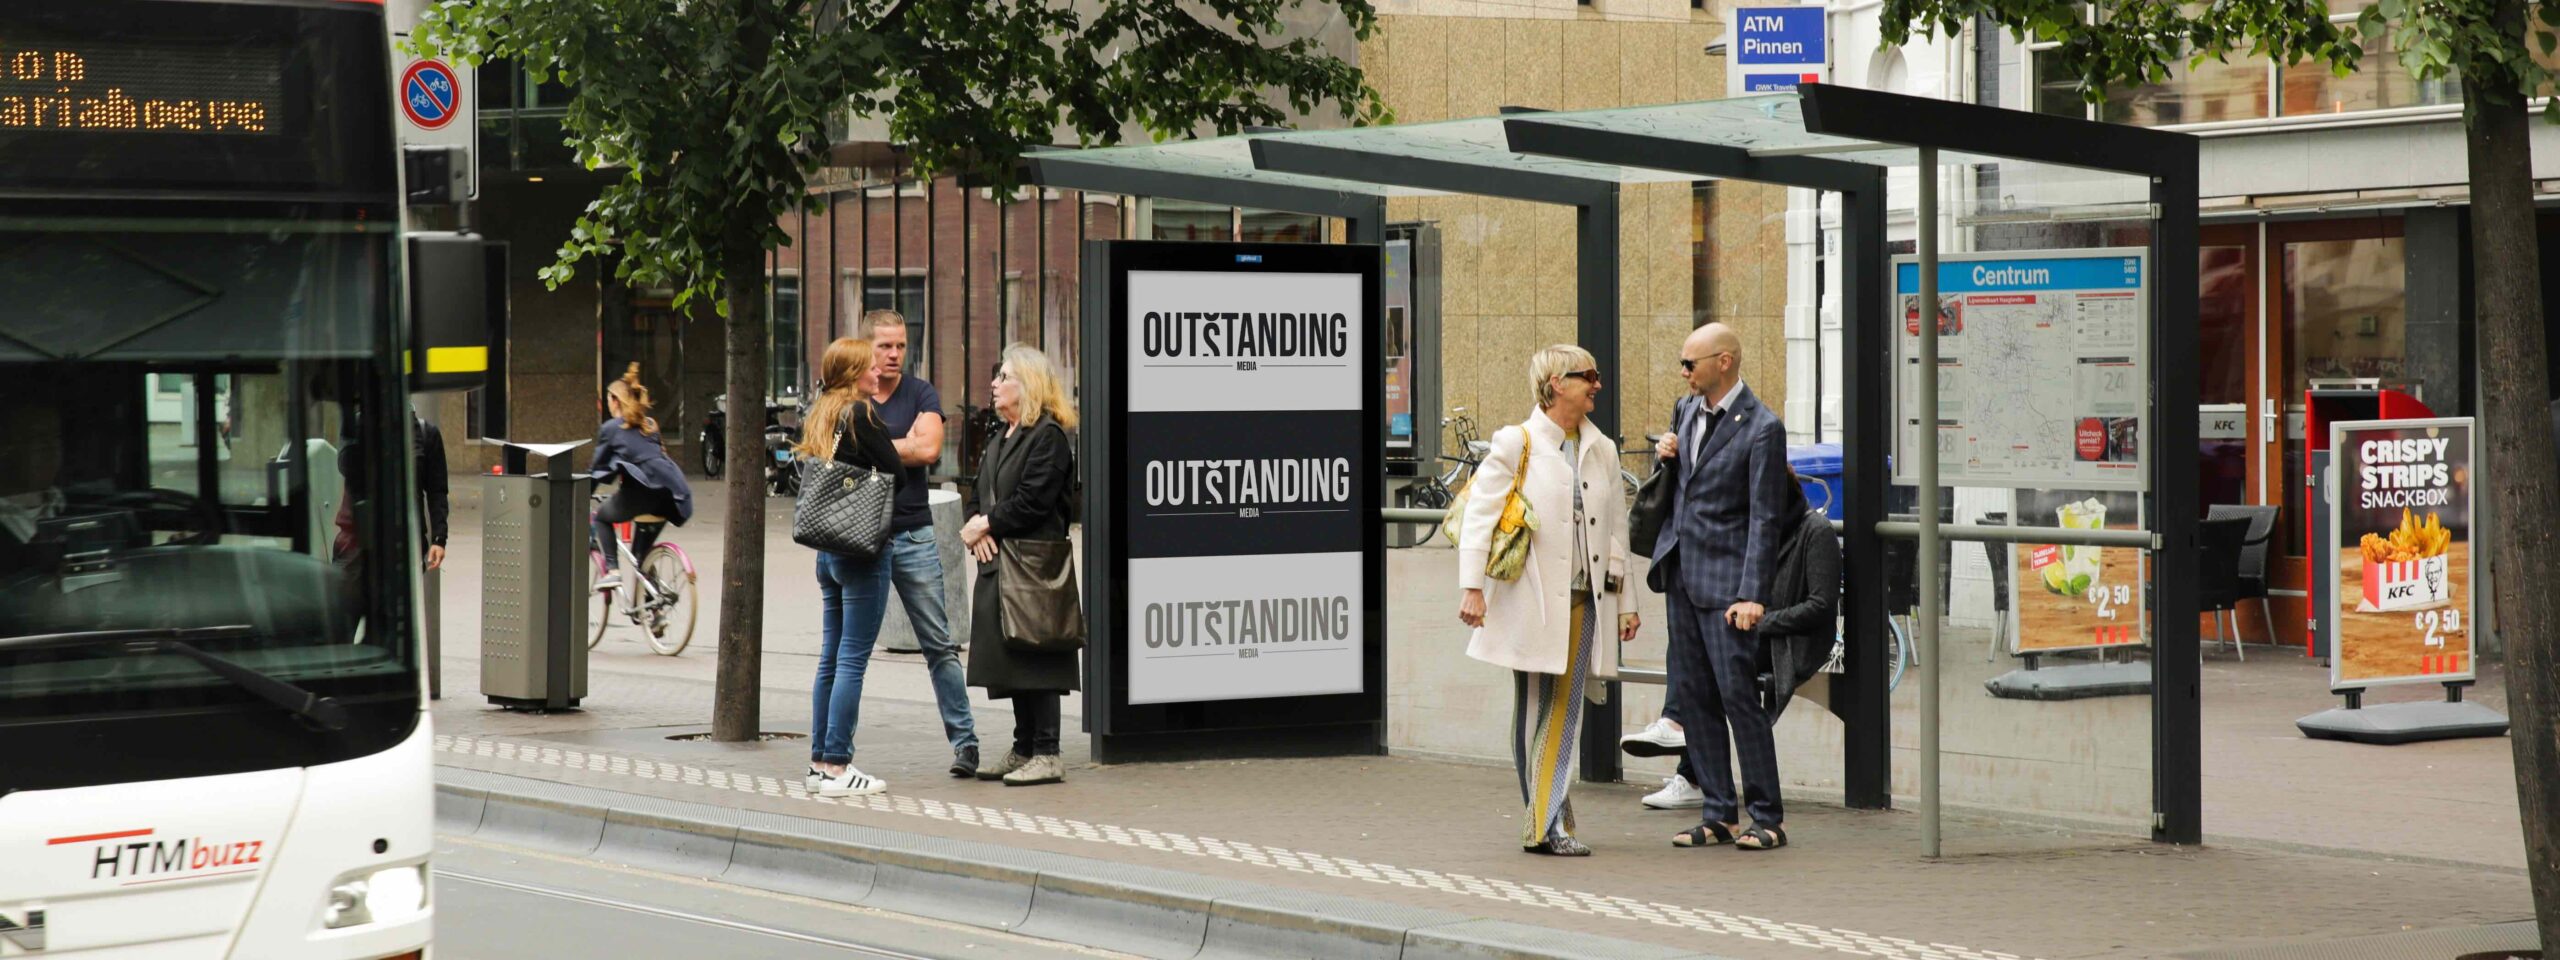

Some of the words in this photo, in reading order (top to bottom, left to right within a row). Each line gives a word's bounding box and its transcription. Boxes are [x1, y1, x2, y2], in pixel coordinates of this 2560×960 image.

[1743, 16, 1784, 32] ATM
[1744, 38, 1803, 55] Pinnen
[1972, 265, 2050, 287] Centrum
[1143, 311, 1348, 358] OUTSTANDING
[1236, 360, 1258, 372] MEDIA
[2213, 420, 2236, 431] KFC
[2361, 437, 2449, 464] CRISPY
[1146, 457, 1350, 506] OUTSTANDING
[2361, 464, 2449, 490] STRIPS
[2361, 489, 2448, 509] SNACKBOX
[1239, 507, 1260, 519] MEDIA
[2387, 584, 2415, 600] KFC
[1145, 595, 1349, 648] OUTSTANDING
[1238, 647, 1259, 659] MEDIA
